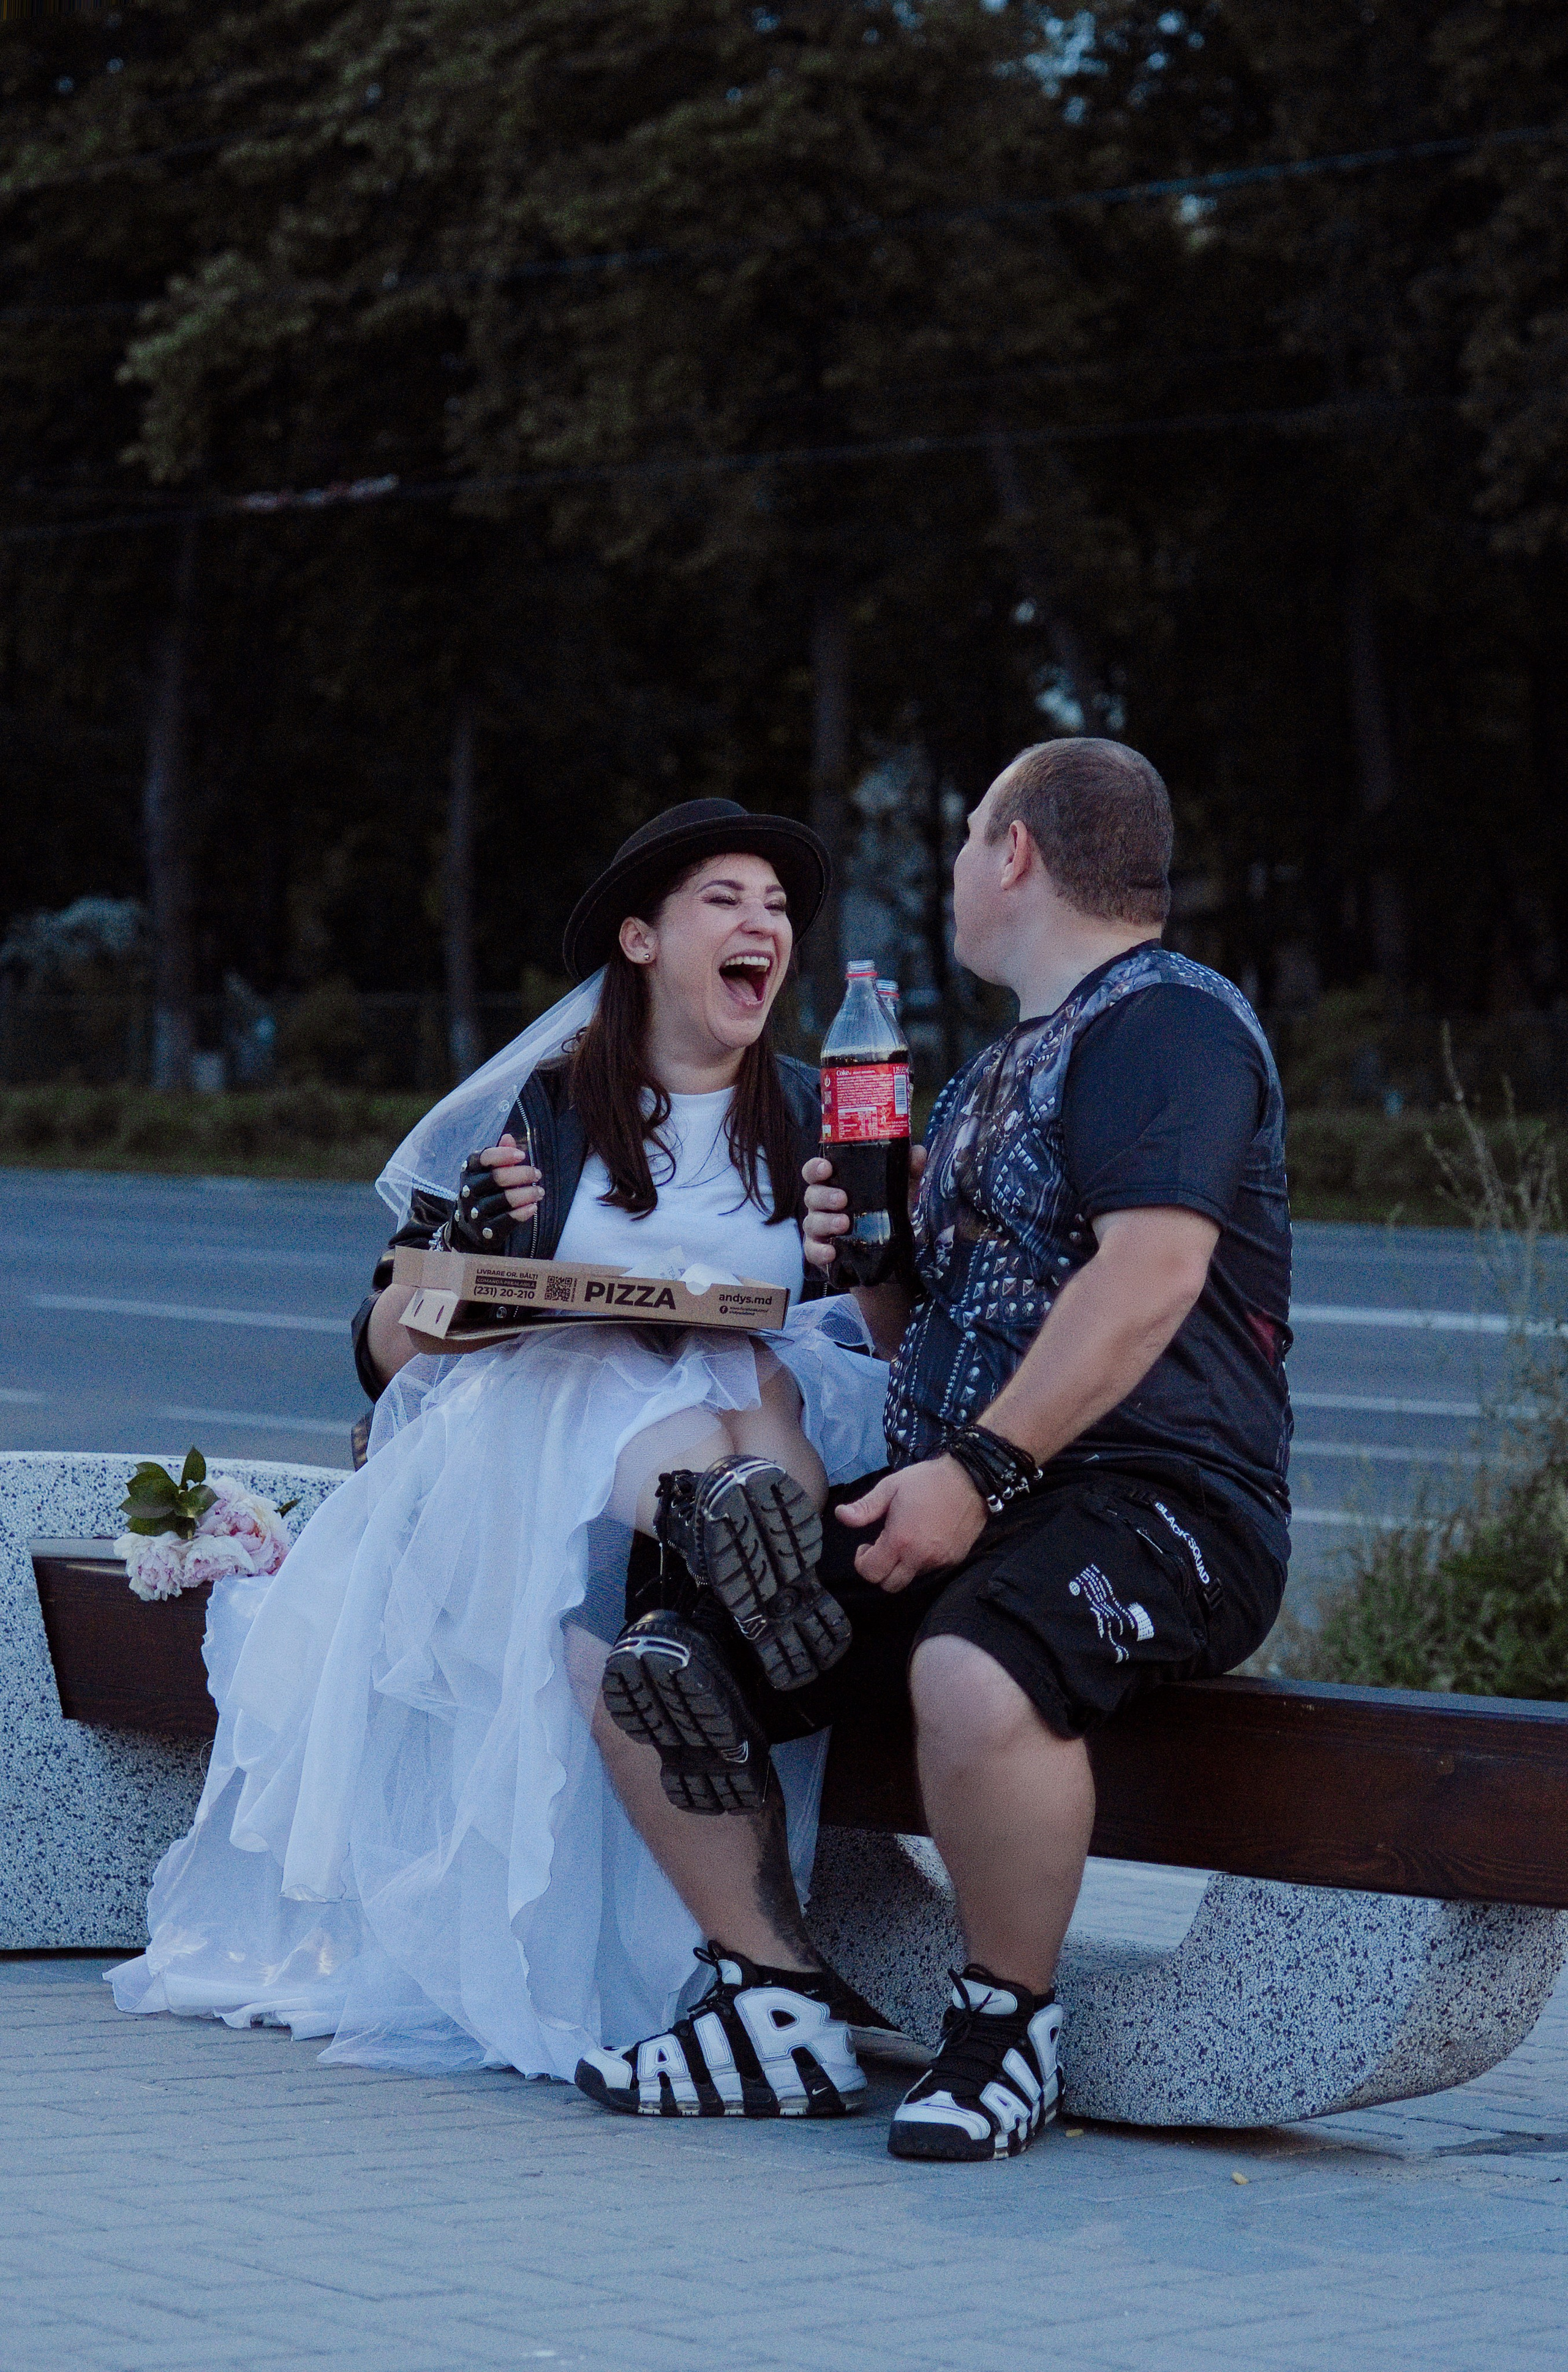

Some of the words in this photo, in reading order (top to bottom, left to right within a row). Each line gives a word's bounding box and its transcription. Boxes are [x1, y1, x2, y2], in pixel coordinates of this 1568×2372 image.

[473, 1285, 497, 1297] (231)
[499, 1288, 535, 1299] 20-210
[584, 1280, 677, 1310] PIZZA
[718, 1293, 773, 1305] andys.md
[1155, 1501, 1190, 1541] BLACK
[1188, 1537, 1210, 1585] SQUAD
[637, 1987, 855, 2080] AIR
